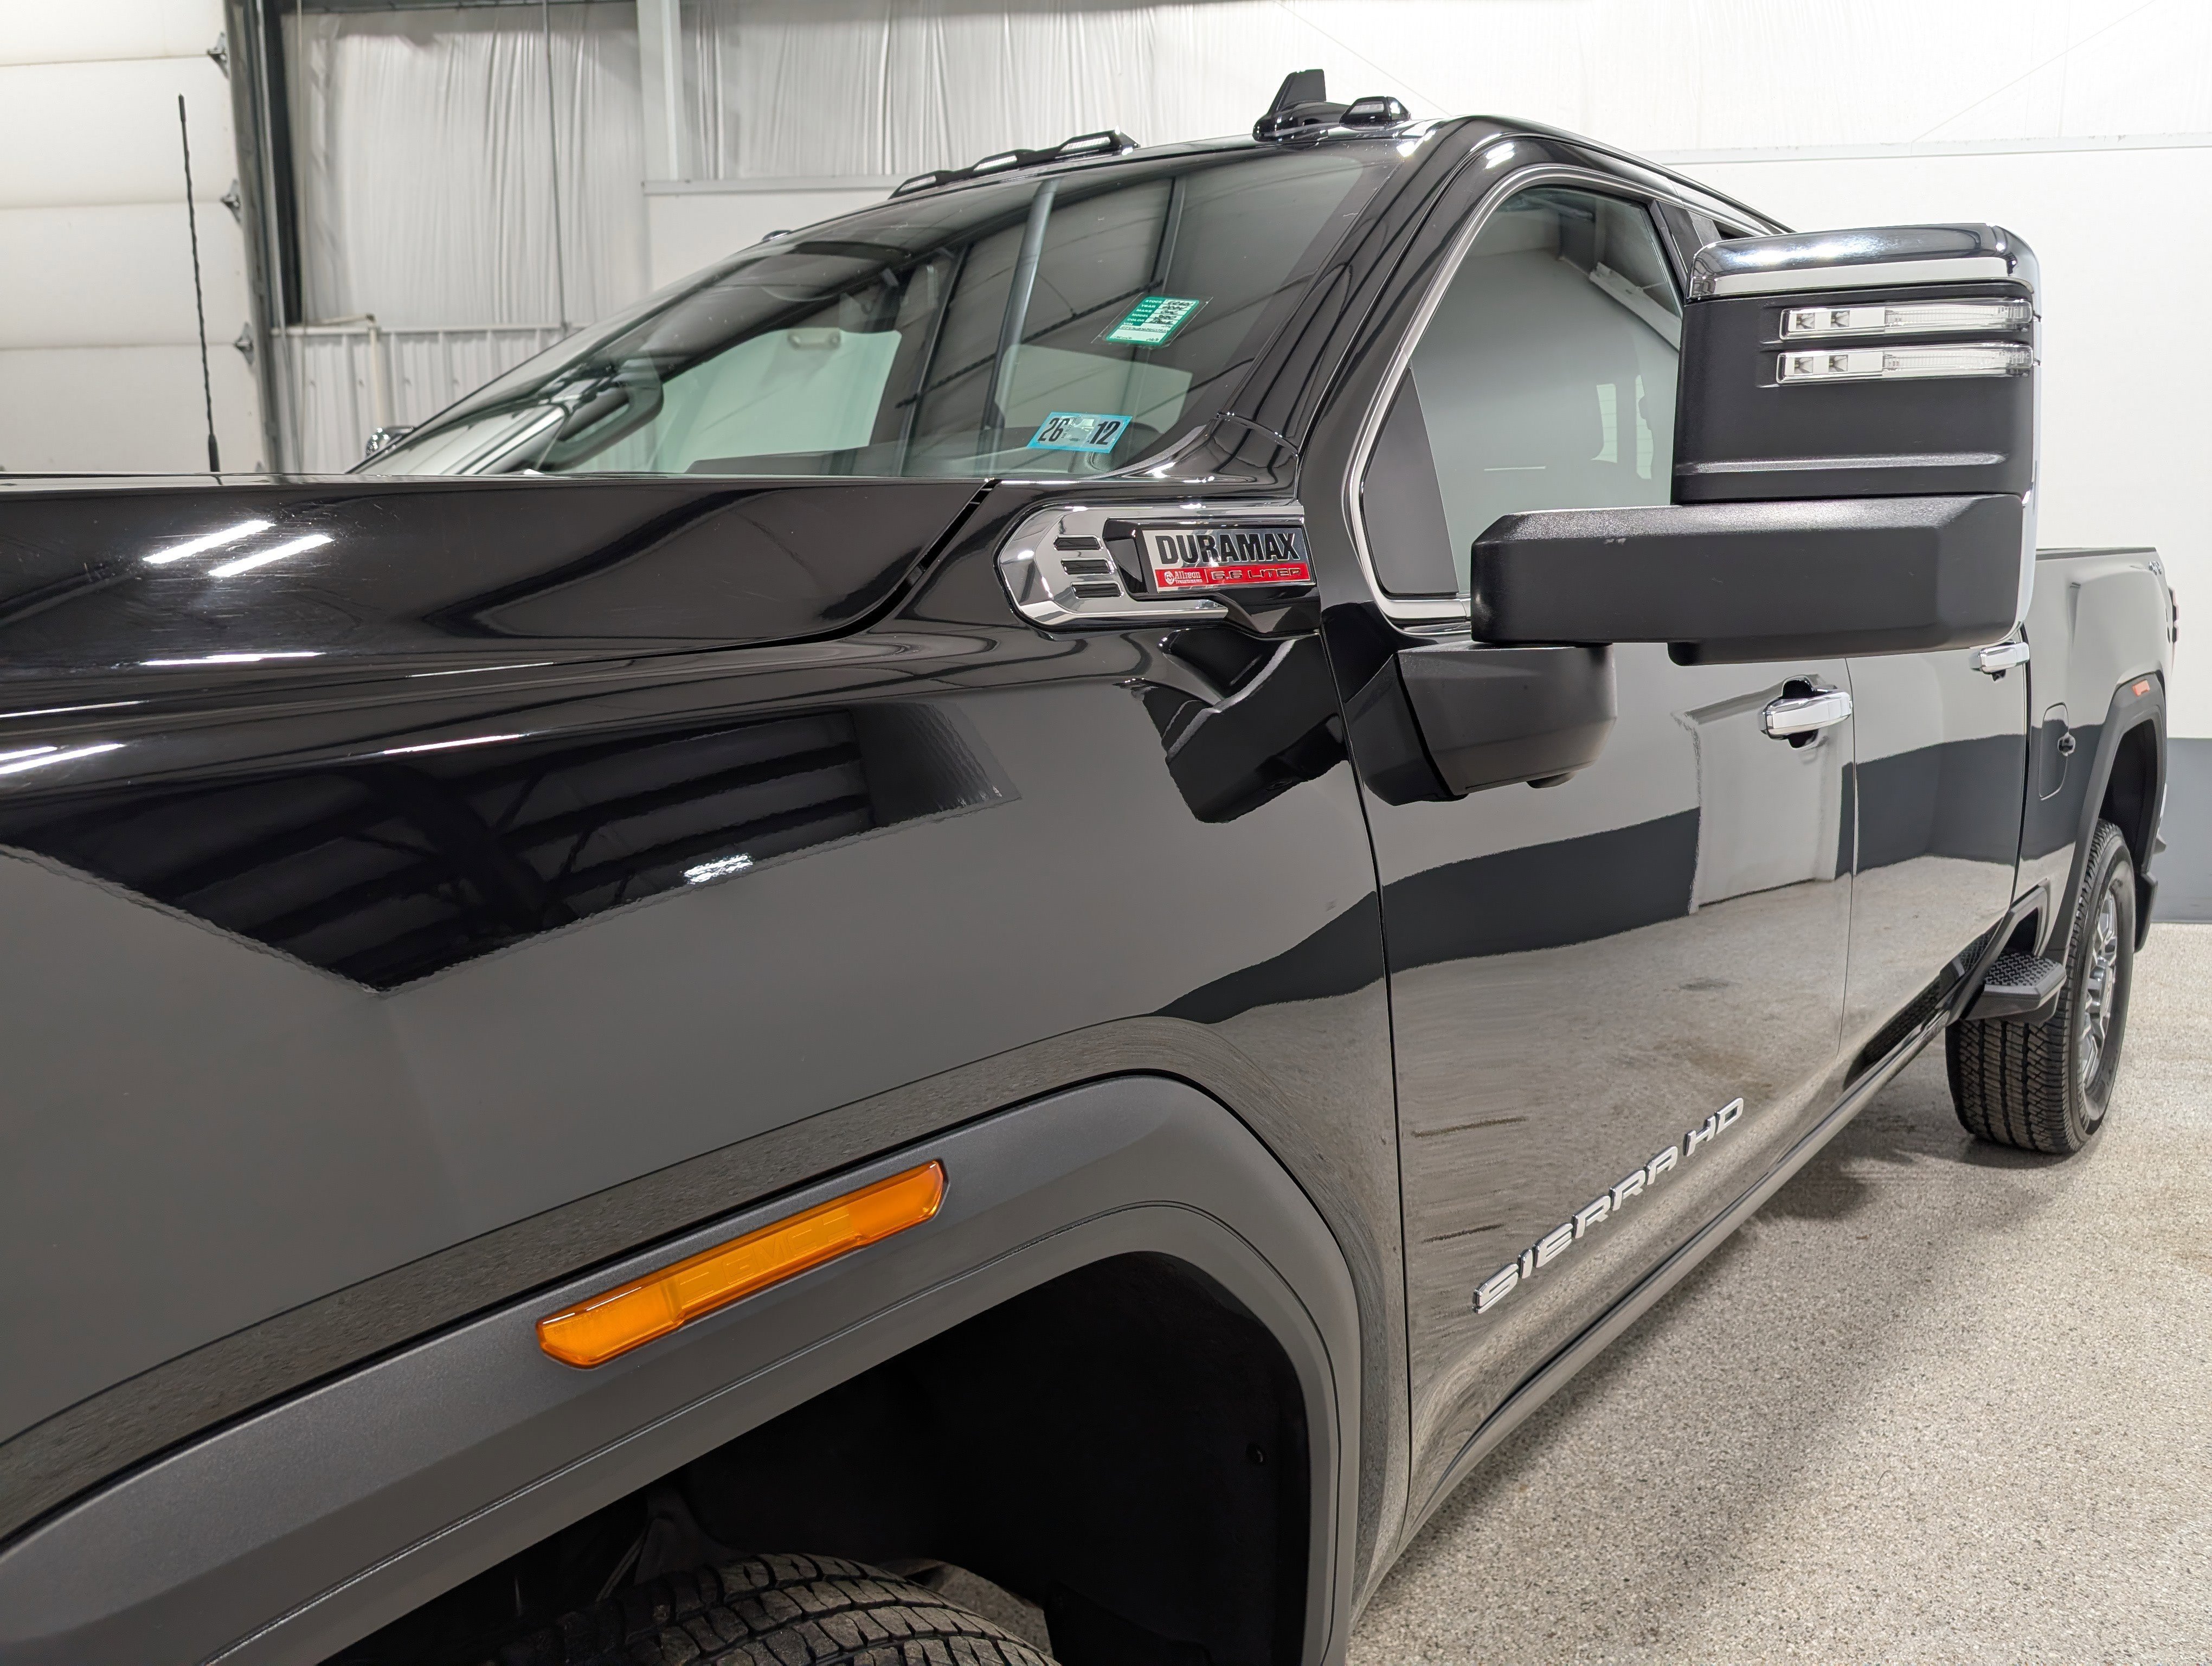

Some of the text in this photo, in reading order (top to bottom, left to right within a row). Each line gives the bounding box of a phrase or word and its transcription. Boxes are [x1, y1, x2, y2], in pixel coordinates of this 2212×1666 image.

[1037, 417, 1071, 442] 26
[1089, 421, 1121, 445] 12
[1155, 533, 1301, 565] DURAMAX
[1174, 571, 1202, 579] Allison
[1211, 567, 1301, 580] 6.6 LITER
[1472, 1097, 1744, 1314] SIERRA HD
[721, 1228, 818, 1285] GMC
